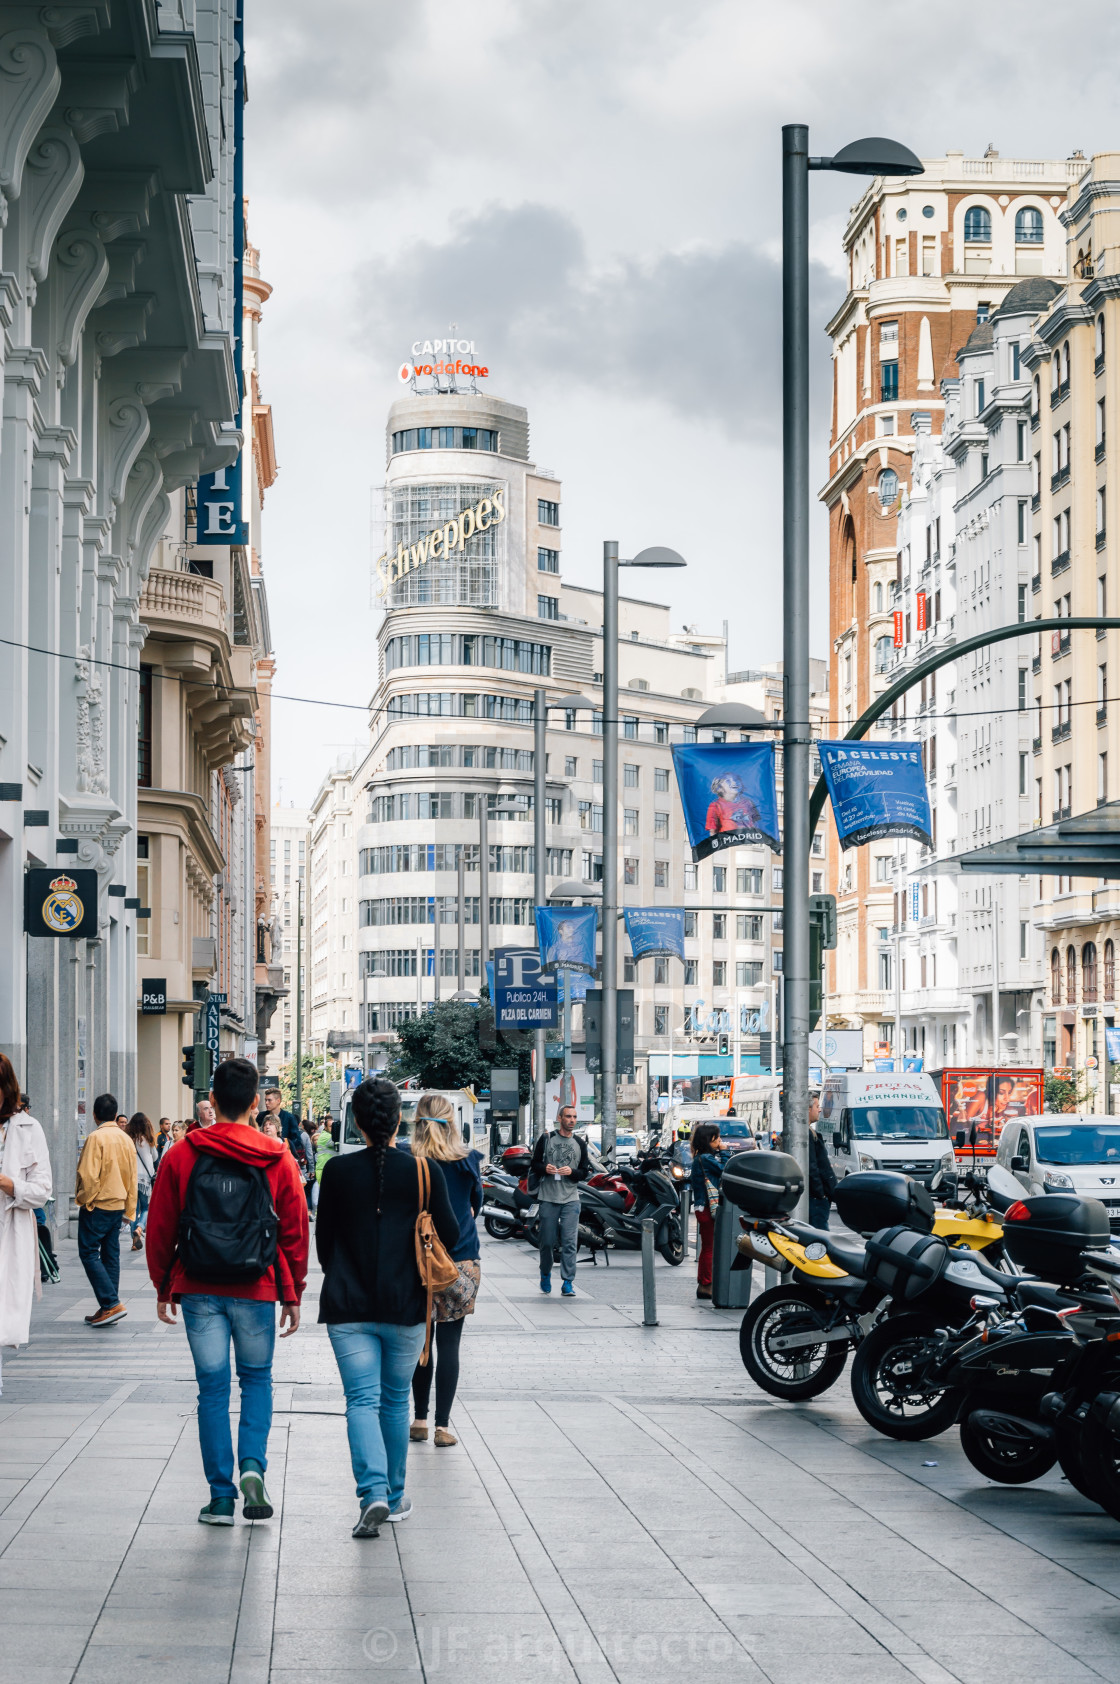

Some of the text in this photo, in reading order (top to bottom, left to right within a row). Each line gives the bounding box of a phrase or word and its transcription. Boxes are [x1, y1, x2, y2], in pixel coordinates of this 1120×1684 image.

[412, 339, 478, 356] CAPITOL
[414, 360, 489, 377] vodafone
[376, 489, 504, 598] Schweppes
[827, 751, 918, 764] LA CELESTE
[832, 765, 867, 779] EUROPEA
[723, 833, 763, 844] MADRID
[143, 994, 165, 1004] P&B
[209, 994, 226, 1002] STAL
[501, 1008, 552, 1020] PLZA DEL CARMEN
[690, 999, 769, 1033] Captol
[865, 1083, 922, 1092] FRUTAS
